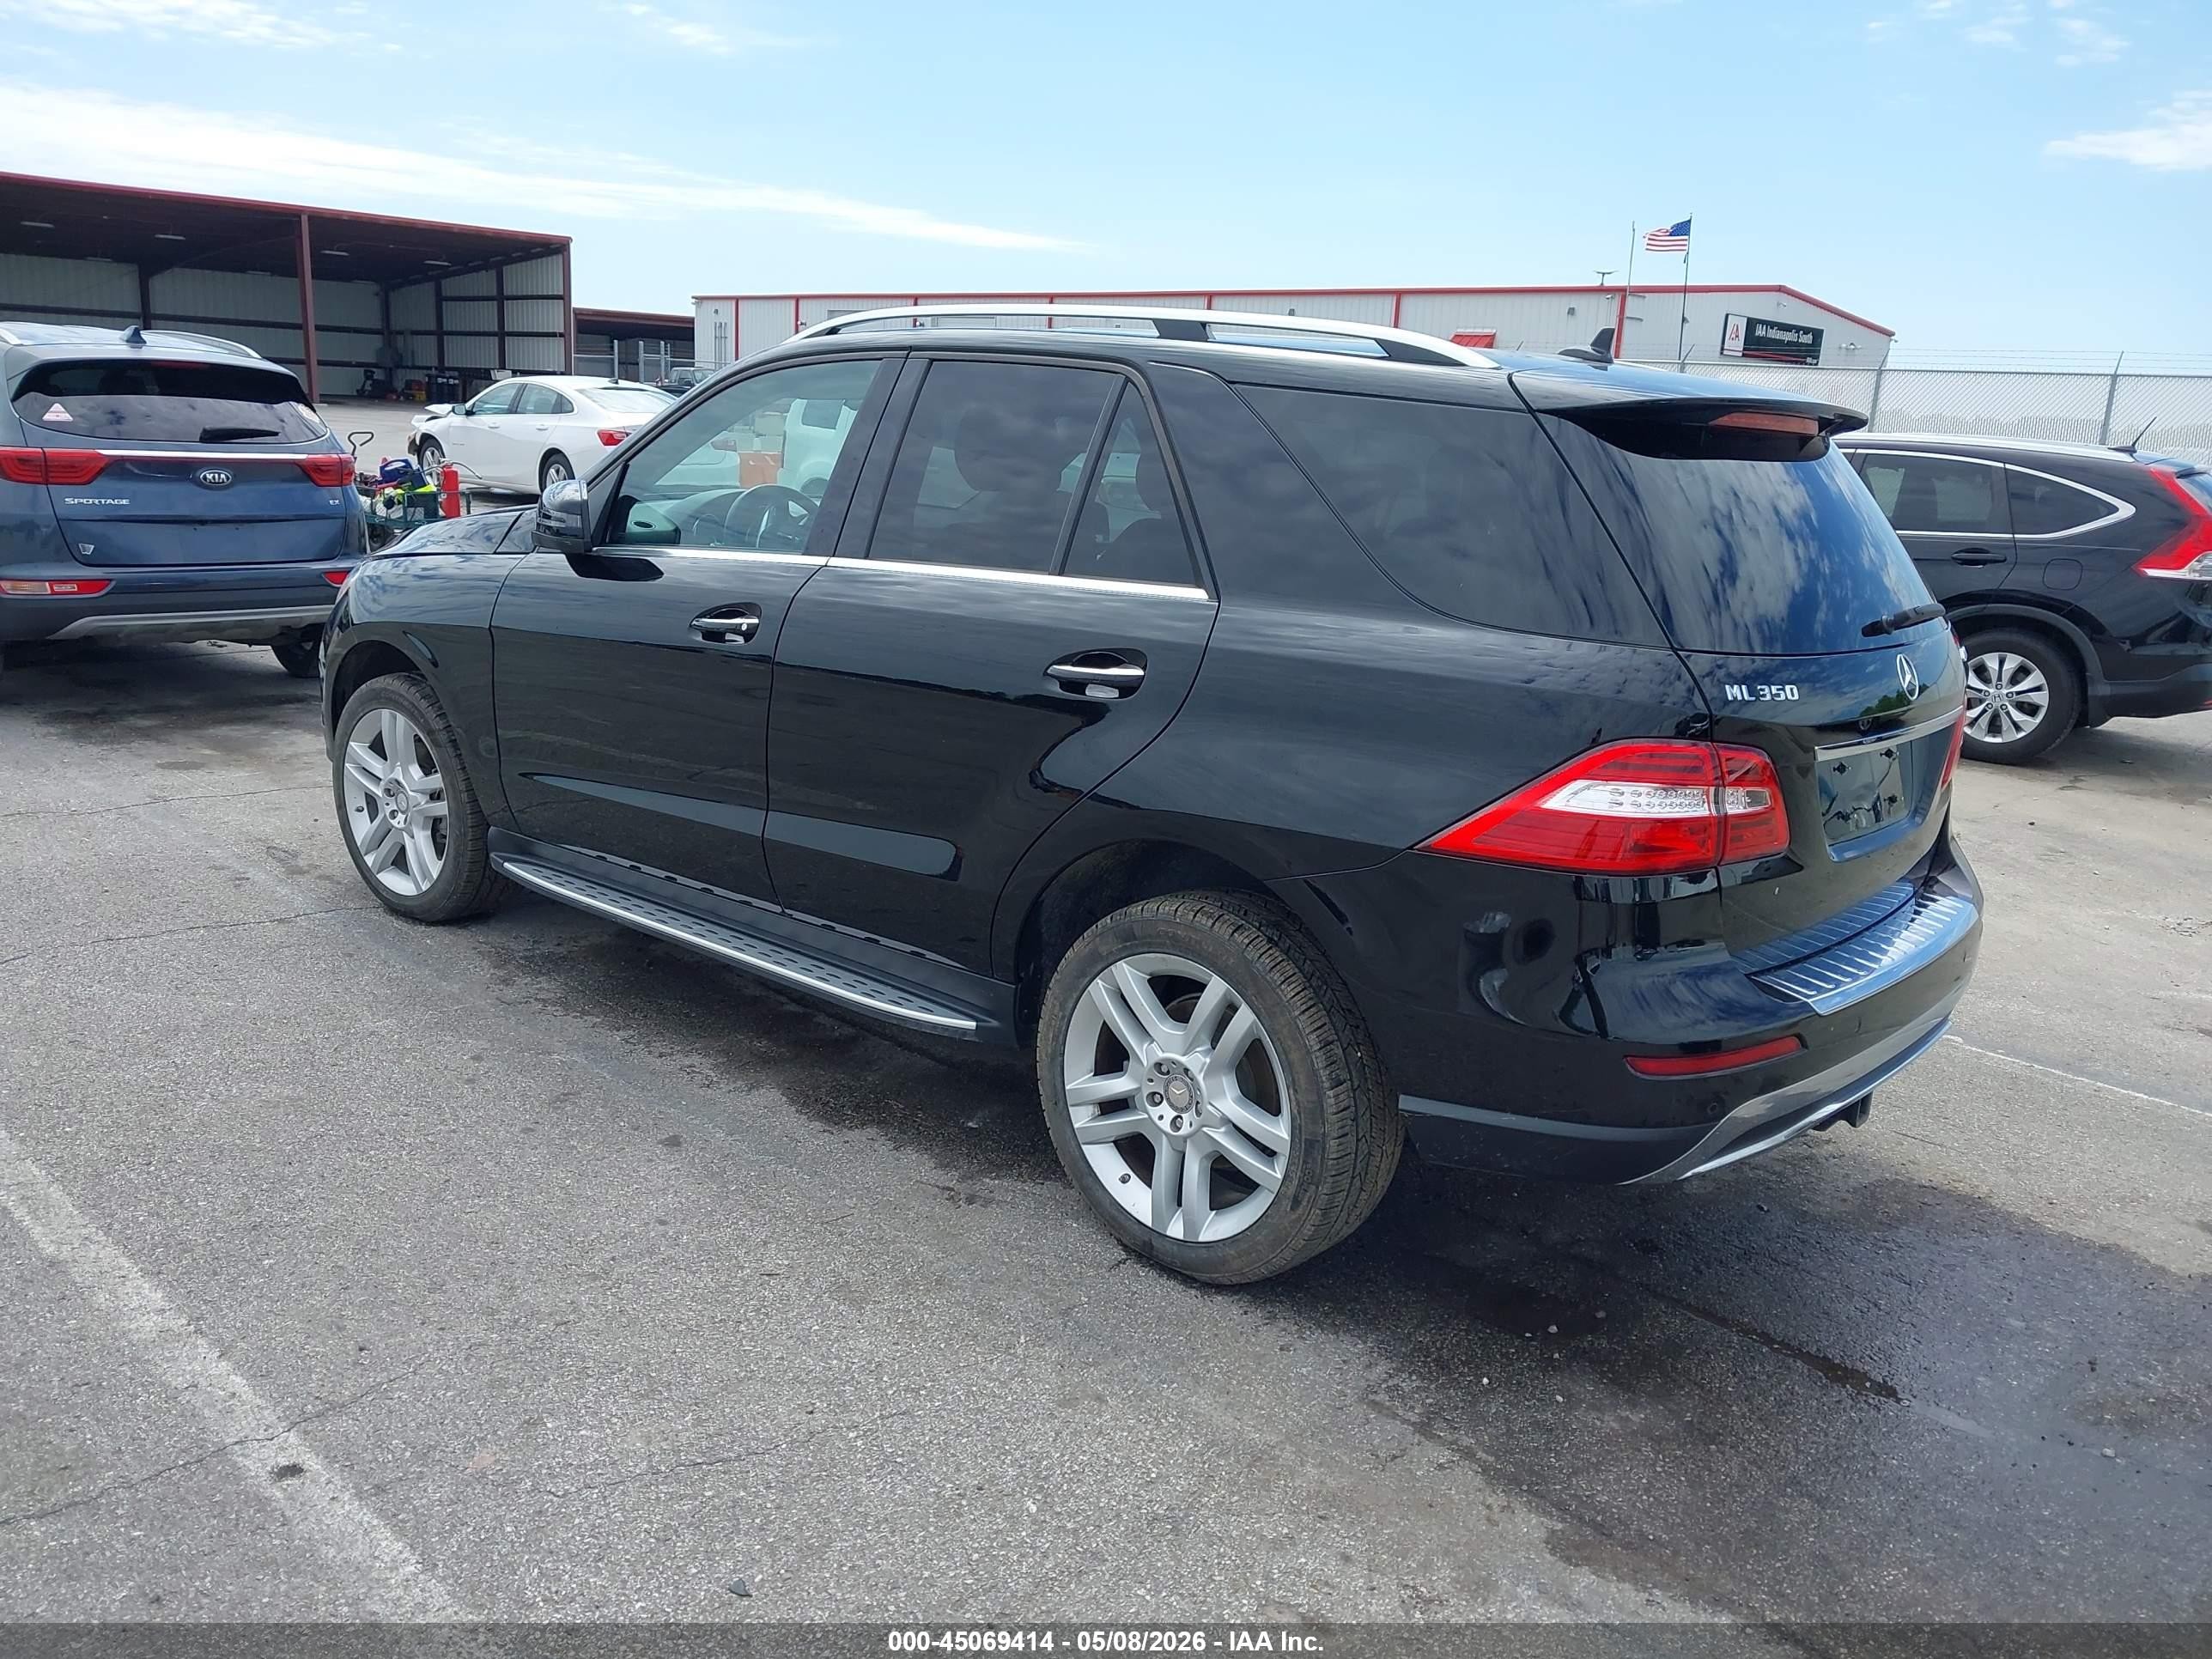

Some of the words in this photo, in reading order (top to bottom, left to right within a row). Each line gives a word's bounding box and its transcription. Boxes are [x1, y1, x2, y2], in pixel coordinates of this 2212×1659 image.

[1755, 323, 1766, 337] IAA
[1766, 325, 1798, 343] Indianapolis
[1798, 330, 1814, 344] South
[64, 497, 131, 506] SPORTAGE
[1724, 684, 1756, 702] ML
[1757, 684, 1800, 702] 350
